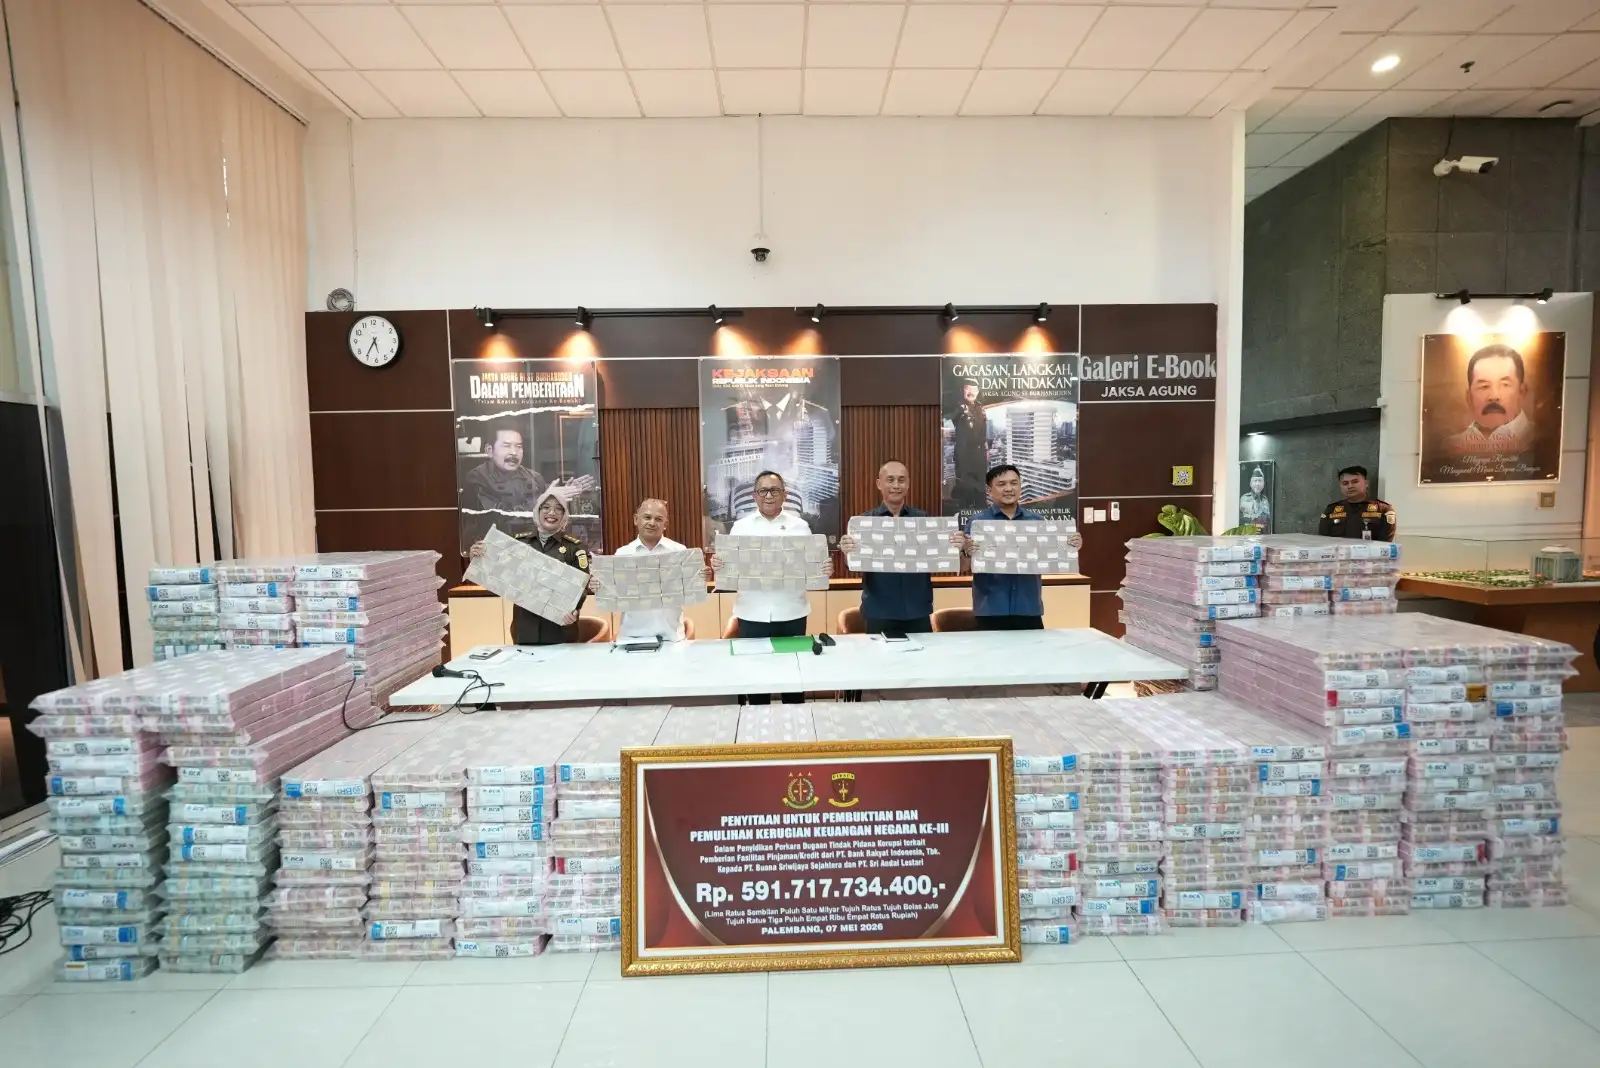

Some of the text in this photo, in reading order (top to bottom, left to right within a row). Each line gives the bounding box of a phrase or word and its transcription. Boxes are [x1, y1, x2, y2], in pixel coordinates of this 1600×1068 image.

[712, 368, 813, 378] KEJAKSAAN
[953, 364, 1072, 377] GAGASAN, LANGKAH,
[1080, 354, 1216, 380] Galeri E-Book
[981, 377, 1072, 389] DAN TINDAKAN
[1101, 386, 1197, 397] JAKSA AGUNG
[1015, 759, 1030, 768] BRI
[721, 810, 918, 826] PENYITAAN UNTUK PEMBUKTIAN DAN
[690, 823, 949, 842] PEMULIHAN KERUGIAN KEUANGAN NEGARA KE-III
[737, 844, 773, 854] Penyidikan
[802, 842, 827, 851] Dugaan
[878, 839, 901, 848] Korupsi
[700, 855, 735, 864] Pemberian
[737, 854, 764, 862] Fasilitas
[767, 851, 819, 862] Pinjaman/Kredit
[848, 849, 864, 857] Bank
[866, 848, 889, 858] Rakyat
[891, 847, 924, 856] Indonesia,
[718, 865, 742, 874] Kepada
[744, 864, 754, 872] PT.
[756, 864, 776, 872] Buana
[779, 862, 808, 871] Sriwijaya
[811, 860, 842, 870] Sejahtera
[844, 860, 856, 869] dan
[858, 860, 868, 868] PT.
[881, 858, 899, 866] Andal
[901, 858, 924, 866] Lestari
[696, 875, 946, 907] Rp. 591.717.734.400,-
[705, 910, 723, 918] (Lima
[819, 905, 839, 913] Milyar
[842, 905, 859, 913] Tujuh
[883, 904, 901, 912] Tujuh
[726, 917, 745, 925] Tujuh
[768, 916, 783, 925] Tiga
[806, 915, 827, 923] Empat
[847, 913, 869, 922] Empat
[892, 912, 918, 920] Rupiah)
[762, 924, 824, 935] PALEMBANG,
